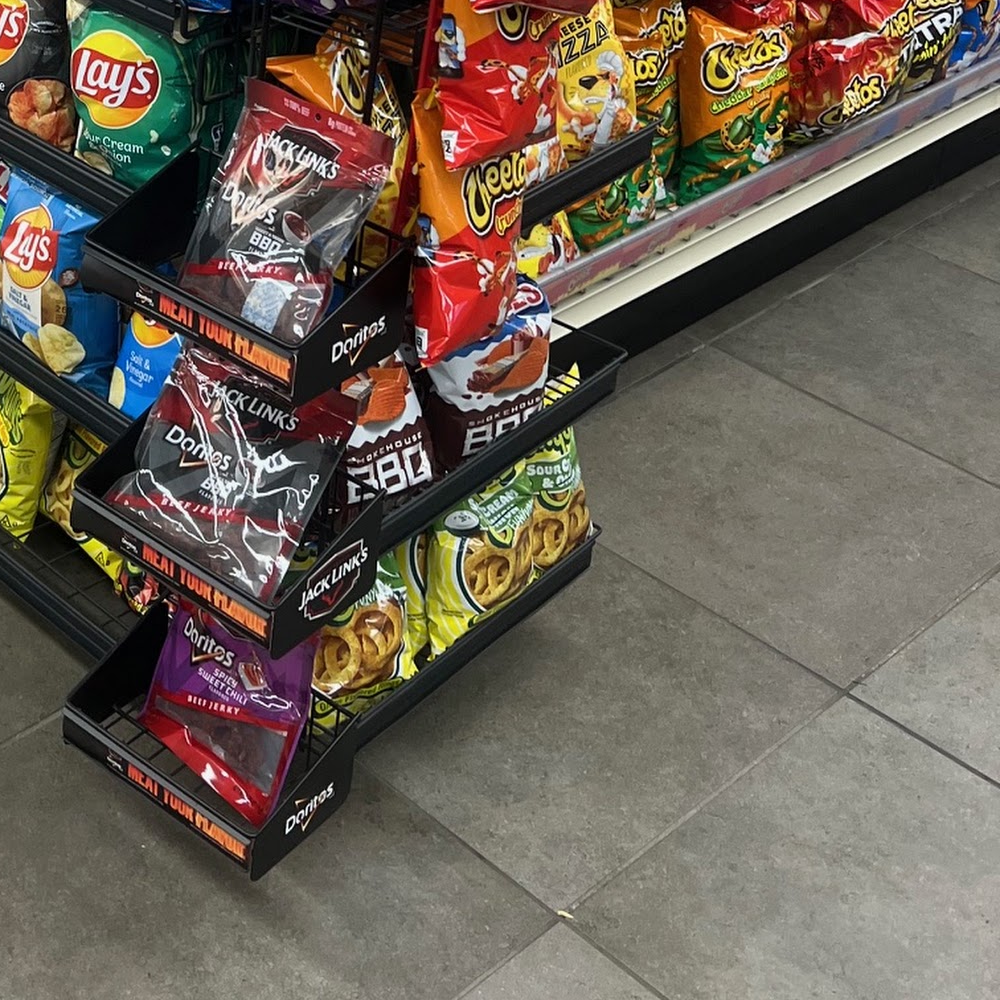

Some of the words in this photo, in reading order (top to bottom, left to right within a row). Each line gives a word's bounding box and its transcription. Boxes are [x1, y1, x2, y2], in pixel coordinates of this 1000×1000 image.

[76, 48, 153, 109] Lay's
[102, 135, 145, 156] Cream
[298, 145, 341, 181] LINK'S
[249, 231, 281, 254] BBQ
[159, 295, 194, 328] MEAT
[198, 315, 233, 351] YOUR
[331, 314, 387, 364] Doritos
[125, 360, 155, 385] Vinegar
[129, 350, 144, 365] Salt
[143, 359, 151, 371] &
[247, 395, 301, 433] LINK'S
[346, 440, 433, 505] BBQ
[526, 464, 560, 477] SOUR
[141, 543, 174, 578] MEAT
[179, 565, 212, 602] YOUR
[299, 575, 333, 611] JACK
[331, 547, 369, 583] LINK'S
[184, 616, 236, 667] Doritos
[197, 666, 226, 692] SWEET
[225, 684, 249, 706] CHILI
[213, 666, 239, 689] SPICY
[187, 695, 208, 709] BEEF
[208, 700, 241, 716] JERKY
[127, 763, 159, 797] MEAT
[163, 785, 194, 823] YOUR
[284, 782, 336, 836] Doritos
